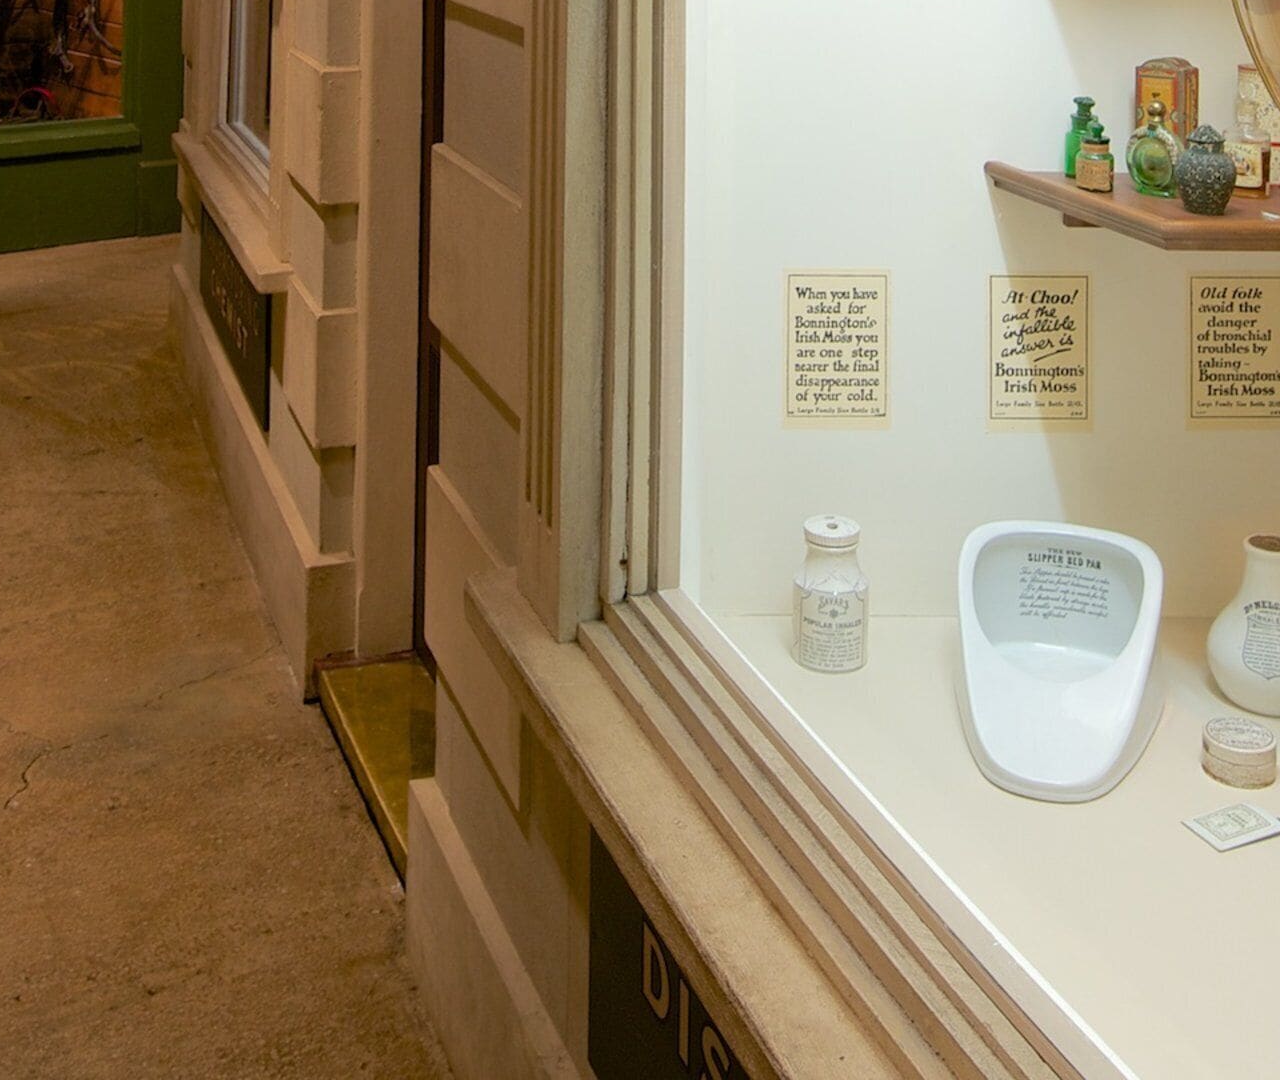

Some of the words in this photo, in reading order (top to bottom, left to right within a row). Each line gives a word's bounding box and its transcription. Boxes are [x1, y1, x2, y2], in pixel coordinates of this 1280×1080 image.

[795, 287, 827, 299] When
[830, 290, 850, 302] you
[852, 287, 878, 300] have
[1200, 287, 1227, 299] Old
[1232, 286, 1263, 299] folk
[806, 302, 841, 314] asked
[848, 301, 867, 314] for
[1002, 309, 1030, 323] and
[1035, 305, 1057, 319] the
[1198, 301, 1234, 313] avoid
[1239, 301, 1261, 313] the
[795, 316, 877, 333] Bonnington's
[1003, 315, 1076, 345] infallible
[1207, 315, 1258, 331] danger
[795, 330, 820, 343] Irish
[822, 331, 853, 343] Moss
[855, 334, 879, 347] you
[1196, 329, 1210, 341] of
[1213, 329, 1272, 341] bronchial
[1001, 339, 1054, 358] answer
[1059, 333, 1074, 346] is
[1197, 342, 1250, 354] troubles
[1253, 343, 1268, 356] by
[796, 349, 816, 358] are
[819, 349, 843, 358] one
[851, 347, 879, 361] step
[794, 362, 830, 372] nearer
[833, 360, 850, 372] the
[853, 360, 879, 372] final
[995, 362, 1085, 379] Bonnington's
[1198, 358, 1241, 372] taking
[795, 374, 880, 392] disappearance
[1004, 379, 1037, 393] Irish
[1040, 381, 1077, 393] Moss
[1208, 383, 1238, 396] Irish
[1241, 384, 1275, 396] Moss
[795, 388, 810, 401] of
[813, 392, 842, 405] your
[847, 388, 878, 401] cold.
[1027, 552, 1064, 565] SLIPPER
[1067, 556, 1084, 567] BED
[1086, 558, 1102, 570] PAN
